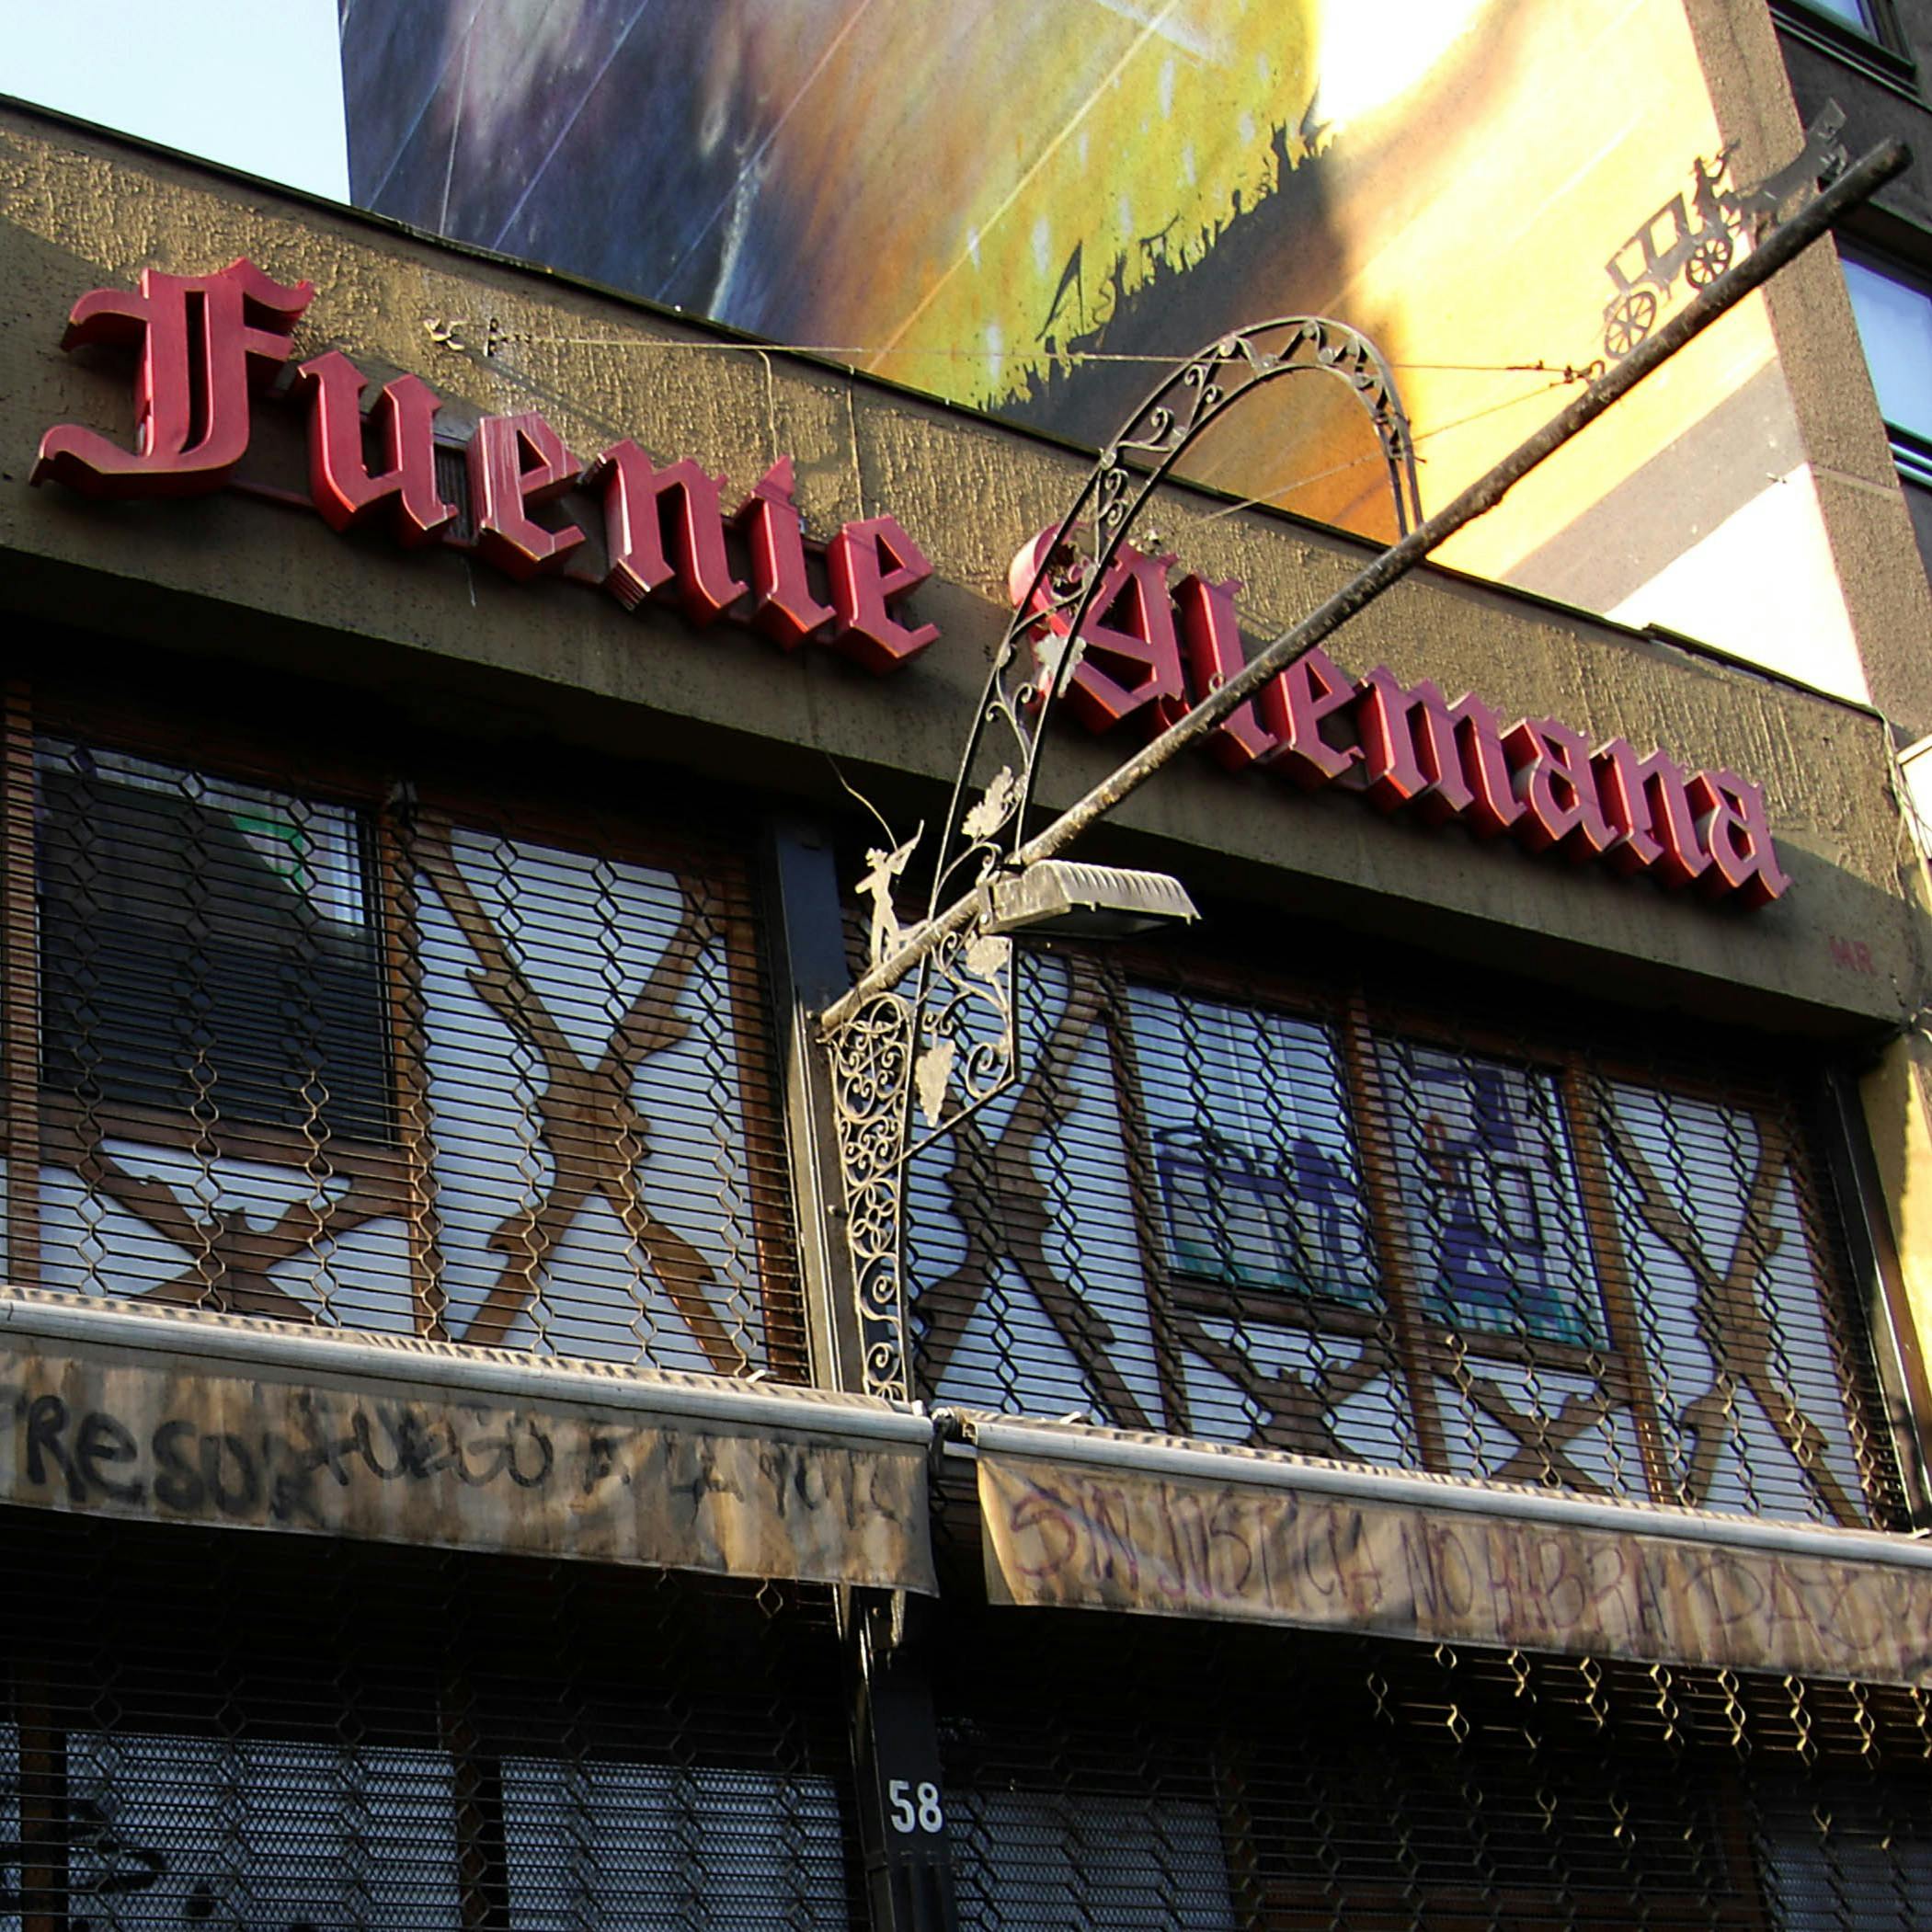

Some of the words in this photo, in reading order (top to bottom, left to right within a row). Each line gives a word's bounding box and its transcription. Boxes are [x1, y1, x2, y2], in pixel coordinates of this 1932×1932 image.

[29, 257, 942, 669] Fuente
[1009, 520, 1793, 909] Alemana
[1398, 1513, 1473, 1622] NO
[888, 1779, 943, 1834] 58
